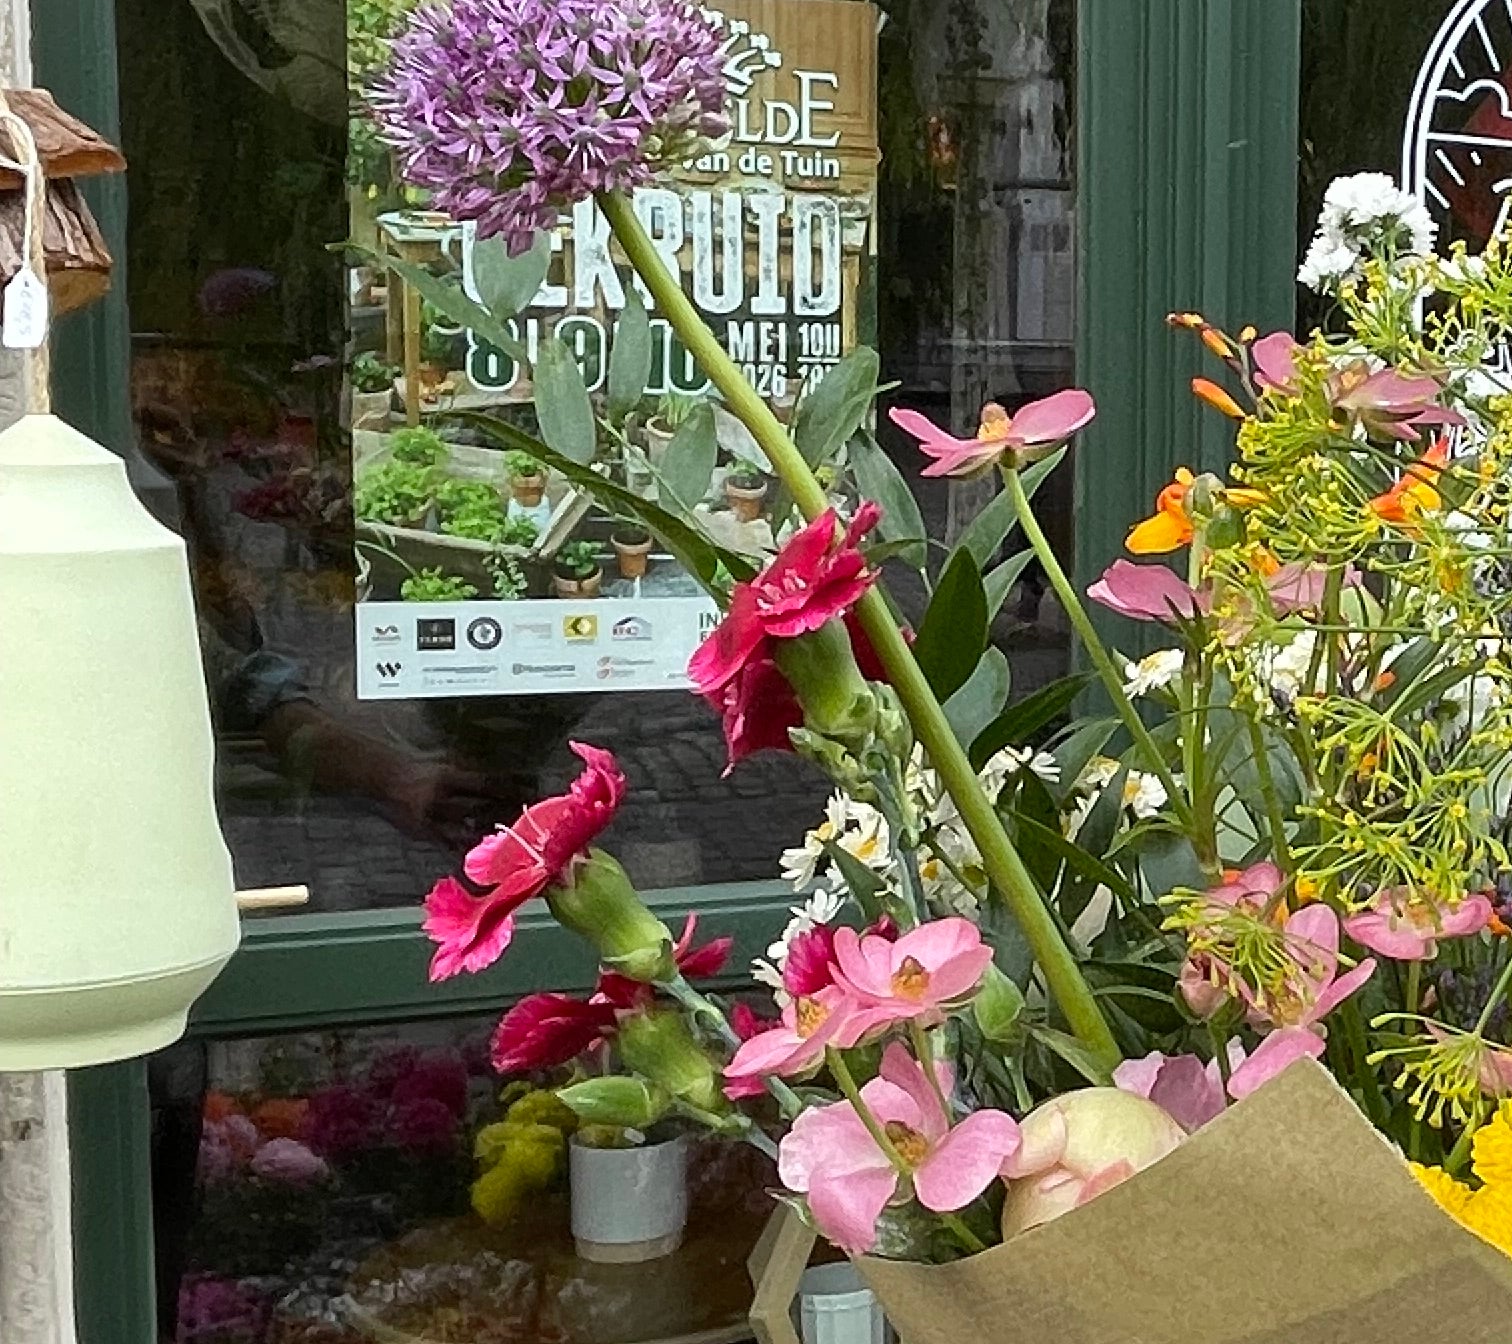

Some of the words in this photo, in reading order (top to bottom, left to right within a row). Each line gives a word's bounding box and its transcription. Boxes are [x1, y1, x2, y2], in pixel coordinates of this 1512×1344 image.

[738, 146, 773, 174] de
[780, 151, 840, 178] Tuin
[462, 186, 841, 317] KRUID
[728, 320, 788, 363] MEI
[740, 362, 788, 398] 026
